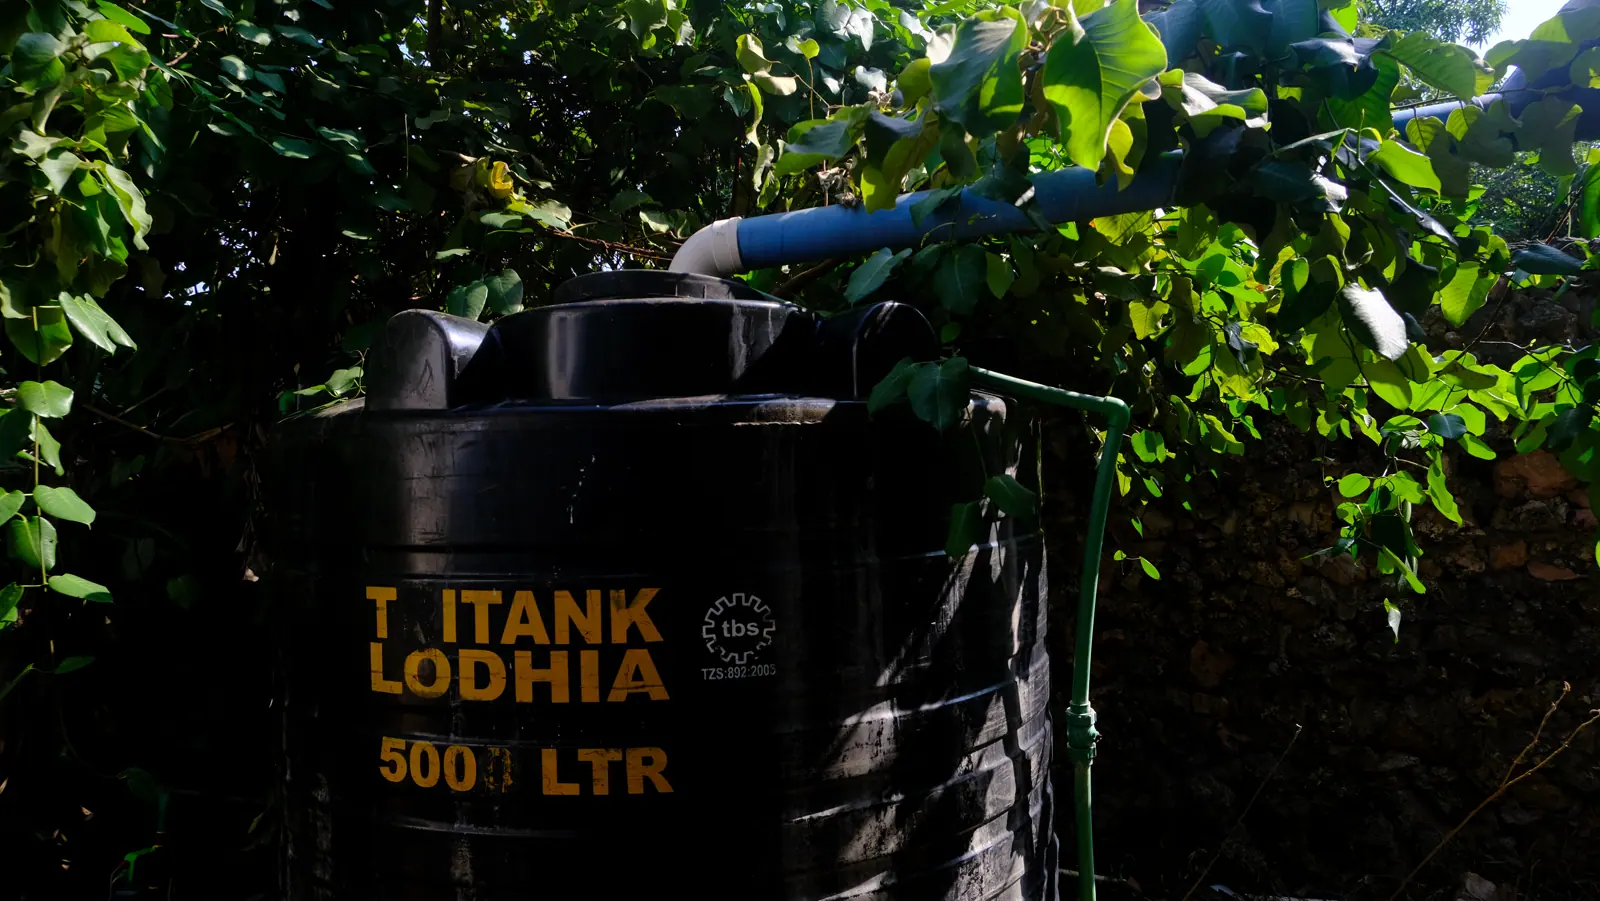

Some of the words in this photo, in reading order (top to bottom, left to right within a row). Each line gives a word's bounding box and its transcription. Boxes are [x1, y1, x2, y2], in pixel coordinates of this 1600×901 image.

[721, 618, 760, 638] tbs
[370, 641, 670, 703] LODHIA
[541, 747, 674, 796] LTR
